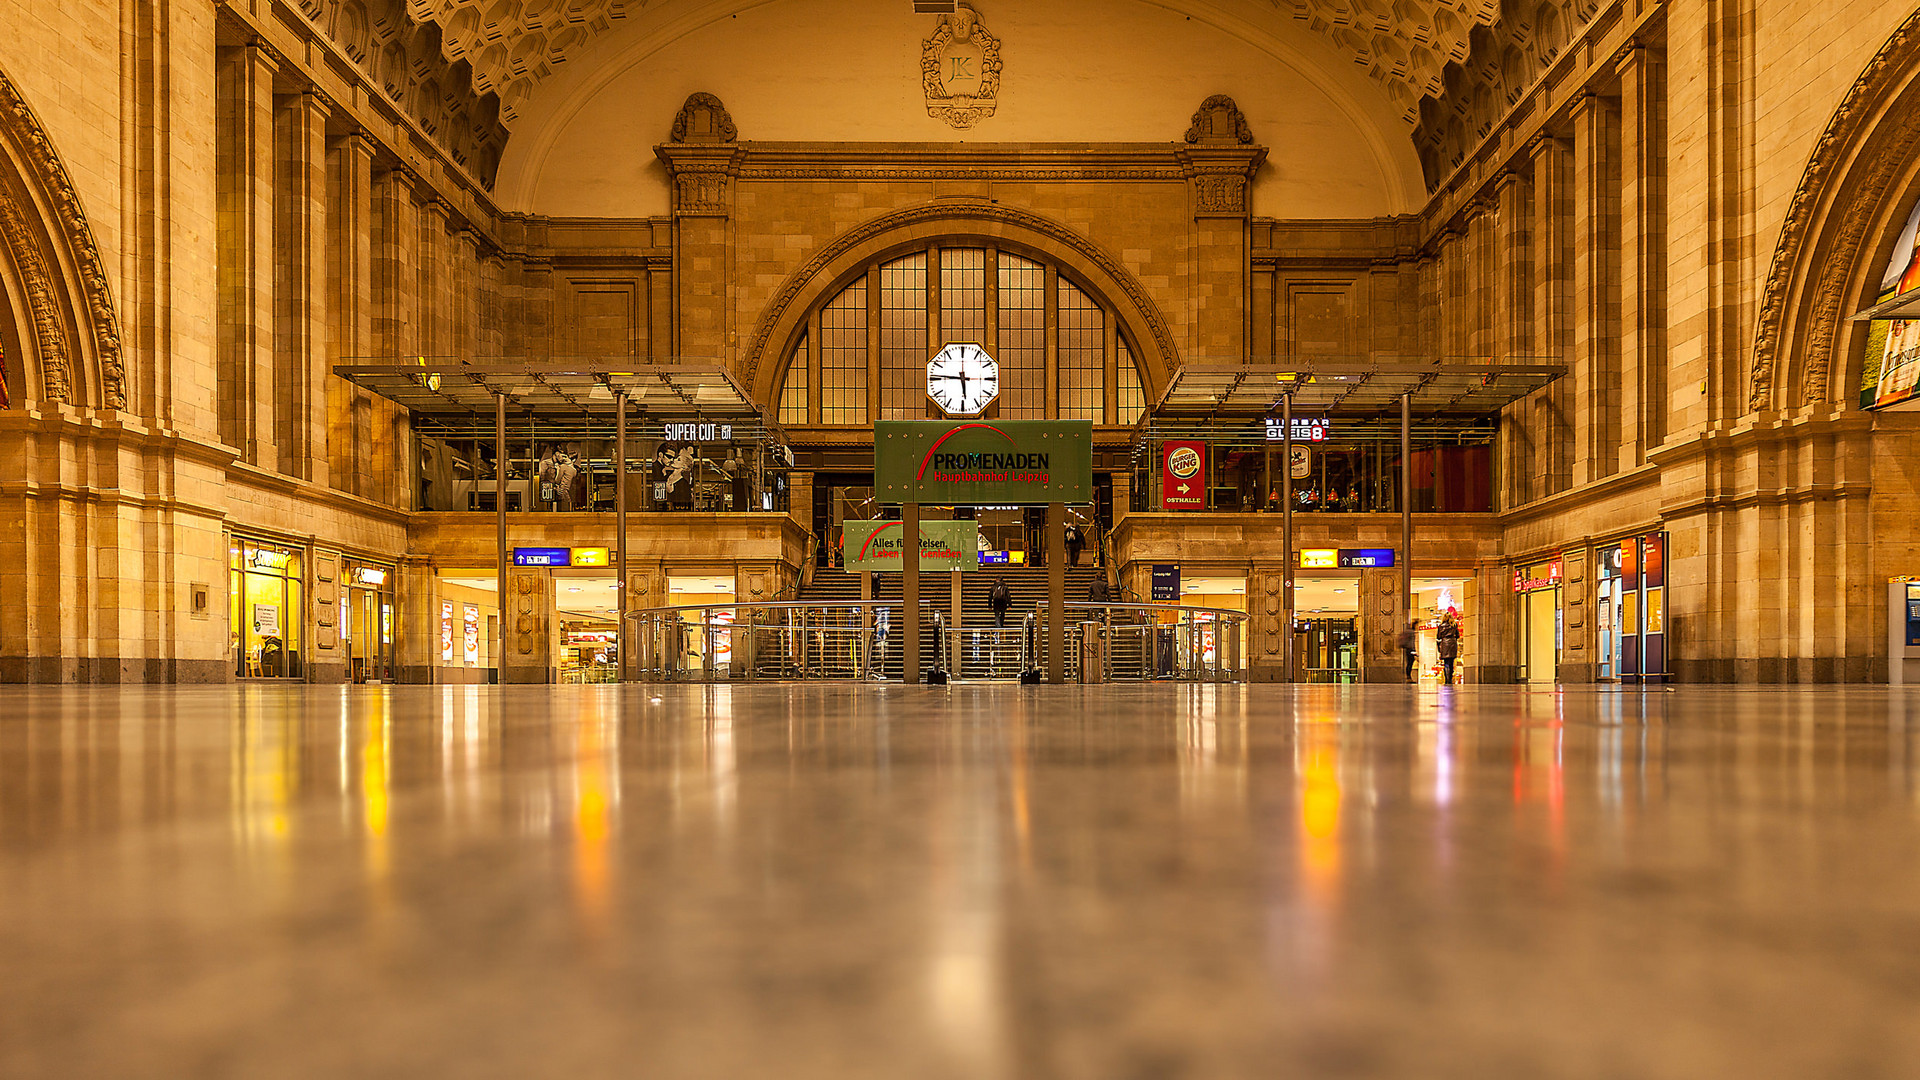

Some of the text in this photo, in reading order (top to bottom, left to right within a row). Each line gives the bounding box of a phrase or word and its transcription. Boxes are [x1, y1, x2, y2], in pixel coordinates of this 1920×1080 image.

[665, 423, 717, 441] SUPER CUT
[934, 453, 1049, 470] PROMENADEN
[1171, 453, 1196, 464] BURGER
[1173, 459, 1197, 471] KING
[934, 471, 1049, 484] Hauptbahnhof Leipzig
[872, 538, 894, 548] Alles
[872, 549, 899, 558] Leben
[921, 548, 962, 558] Genießen
